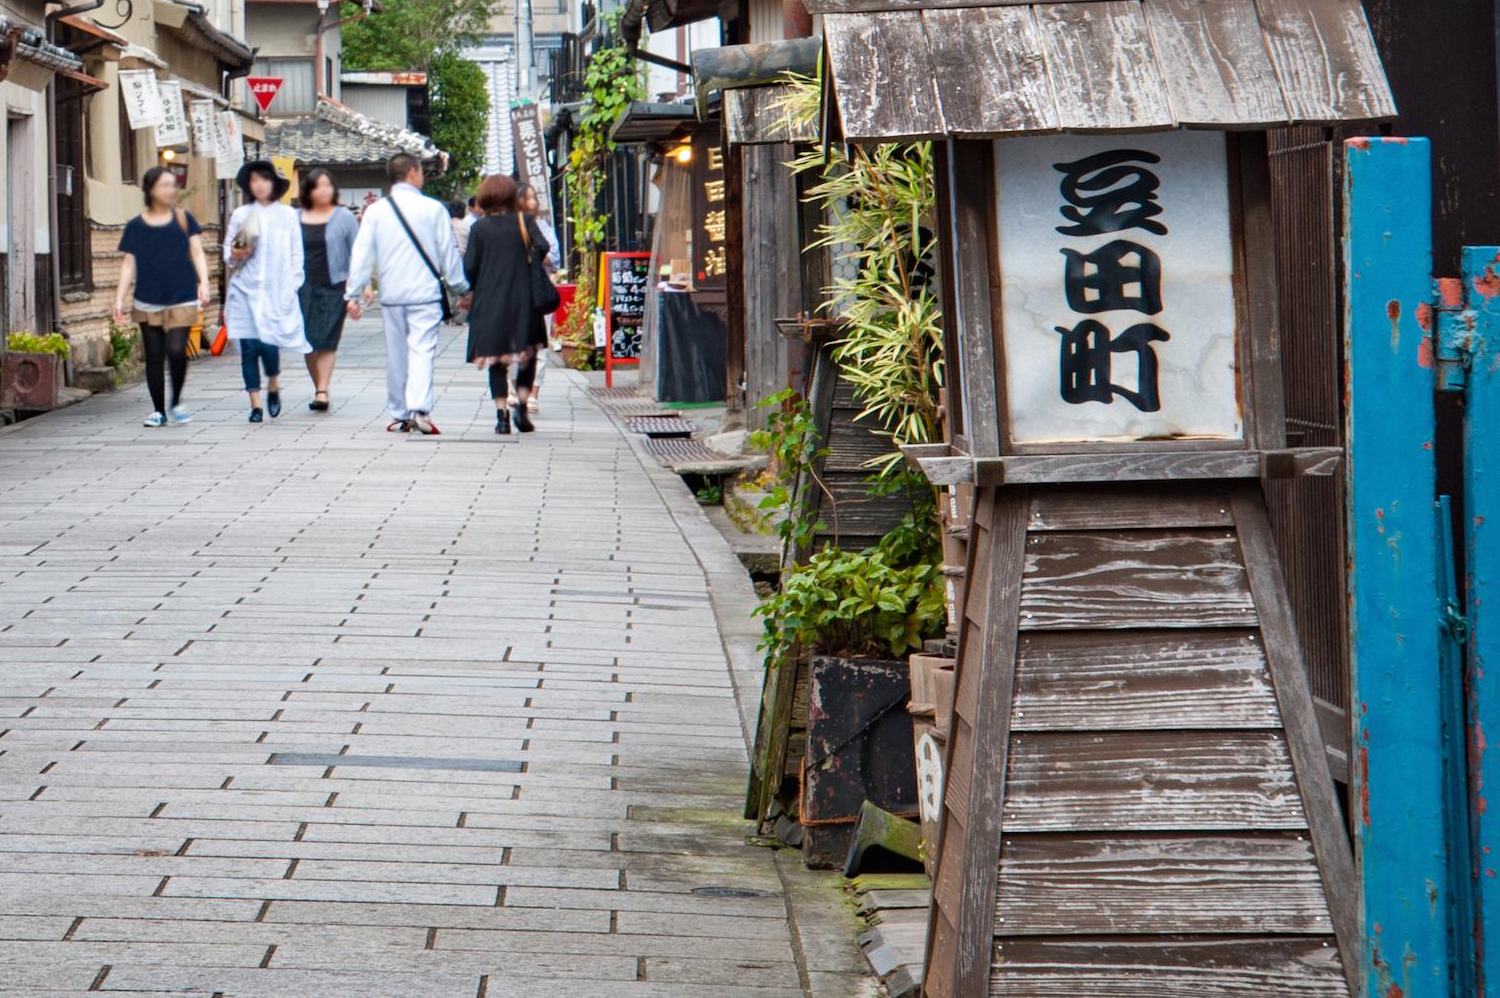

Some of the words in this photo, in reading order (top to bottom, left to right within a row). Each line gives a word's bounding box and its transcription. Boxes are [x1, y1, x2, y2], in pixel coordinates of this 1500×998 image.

[253, 83, 277, 93] 止まれ
[195, 117, 204, 144] みるく
[1051, 148, 1171, 413] 豆田町
